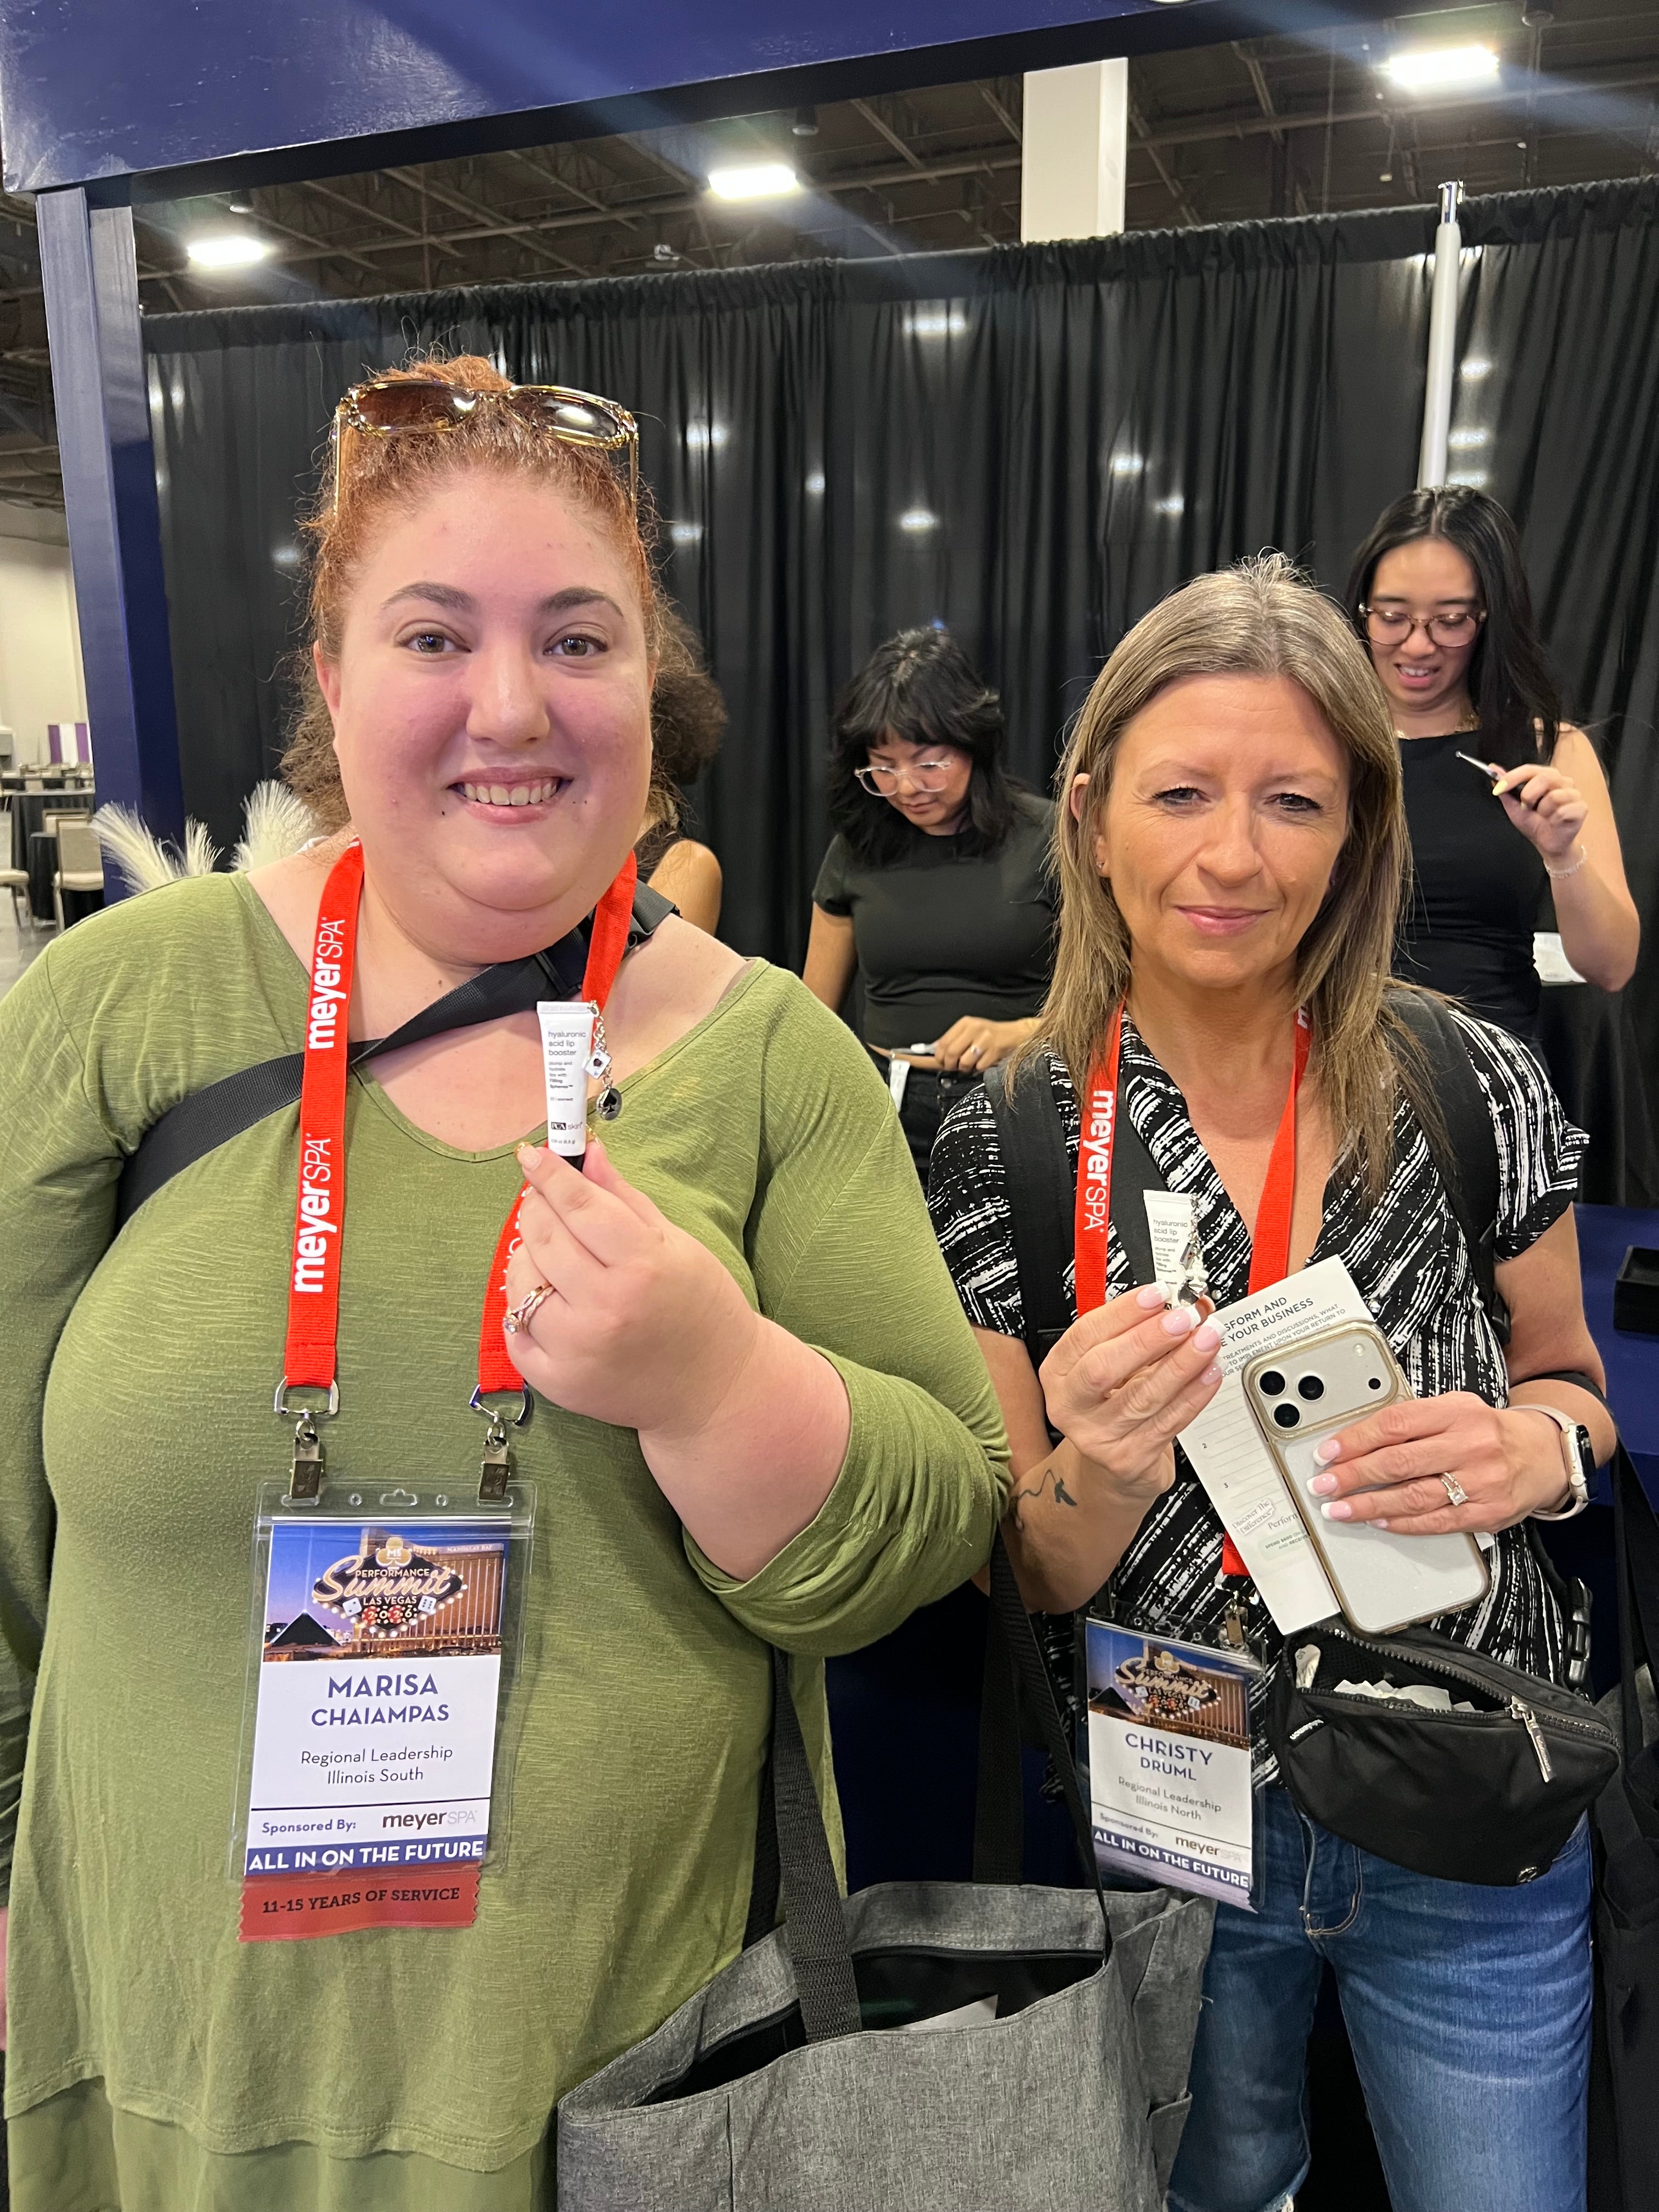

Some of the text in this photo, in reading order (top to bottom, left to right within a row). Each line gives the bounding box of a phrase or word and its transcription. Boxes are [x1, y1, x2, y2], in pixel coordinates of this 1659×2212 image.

[1082, 1090, 1114, 1231] meyerSPA
[1153, 1219, 1188, 1228] hyaluronic
[1154, 1235, 1180, 1244] booster
[1265, 1297, 1287, 1313] AND
[1228, 1298, 1313, 1342] YOUR BUSINESS
[1263, 1334, 1276, 1343] AND
[1319, 1304, 1339, 1316] WHAT
[1292, 1325, 1310, 1336] YOUR
[1310, 1313, 1336, 1328] RETURN
[312, 1555, 451, 1601] Summit
[356, 1568, 430, 1578] PERFORMANCE
[363, 1595, 417, 1606] LAS VEGAS
[367, 1608, 413, 1619] 2026
[328, 1673, 438, 1699] MARISA
[1114, 1656, 1210, 1699] Summit
[311, 1703, 449, 1726] CHAIAMPAS
[301, 1745, 453, 1768] Regional Leadership
[1125, 1733, 1213, 1765] CHRISTY
[328, 1766, 424, 1785] Illinois South
[1141, 1756, 1197, 1781] DRUML
[1118, 1776, 1222, 1813] Regional Leadership
[1136, 1795, 1201, 1821] Illinois North
[262, 1819, 357, 1836] Sponsored By:
[249, 1840, 483, 1871] ALL IN ON THE FUTURE
[1094, 1830, 1249, 1888] ALL IN ON THE FUTURE
[262, 1887, 460, 1914] 11-15 YEARS OF SERVICE
